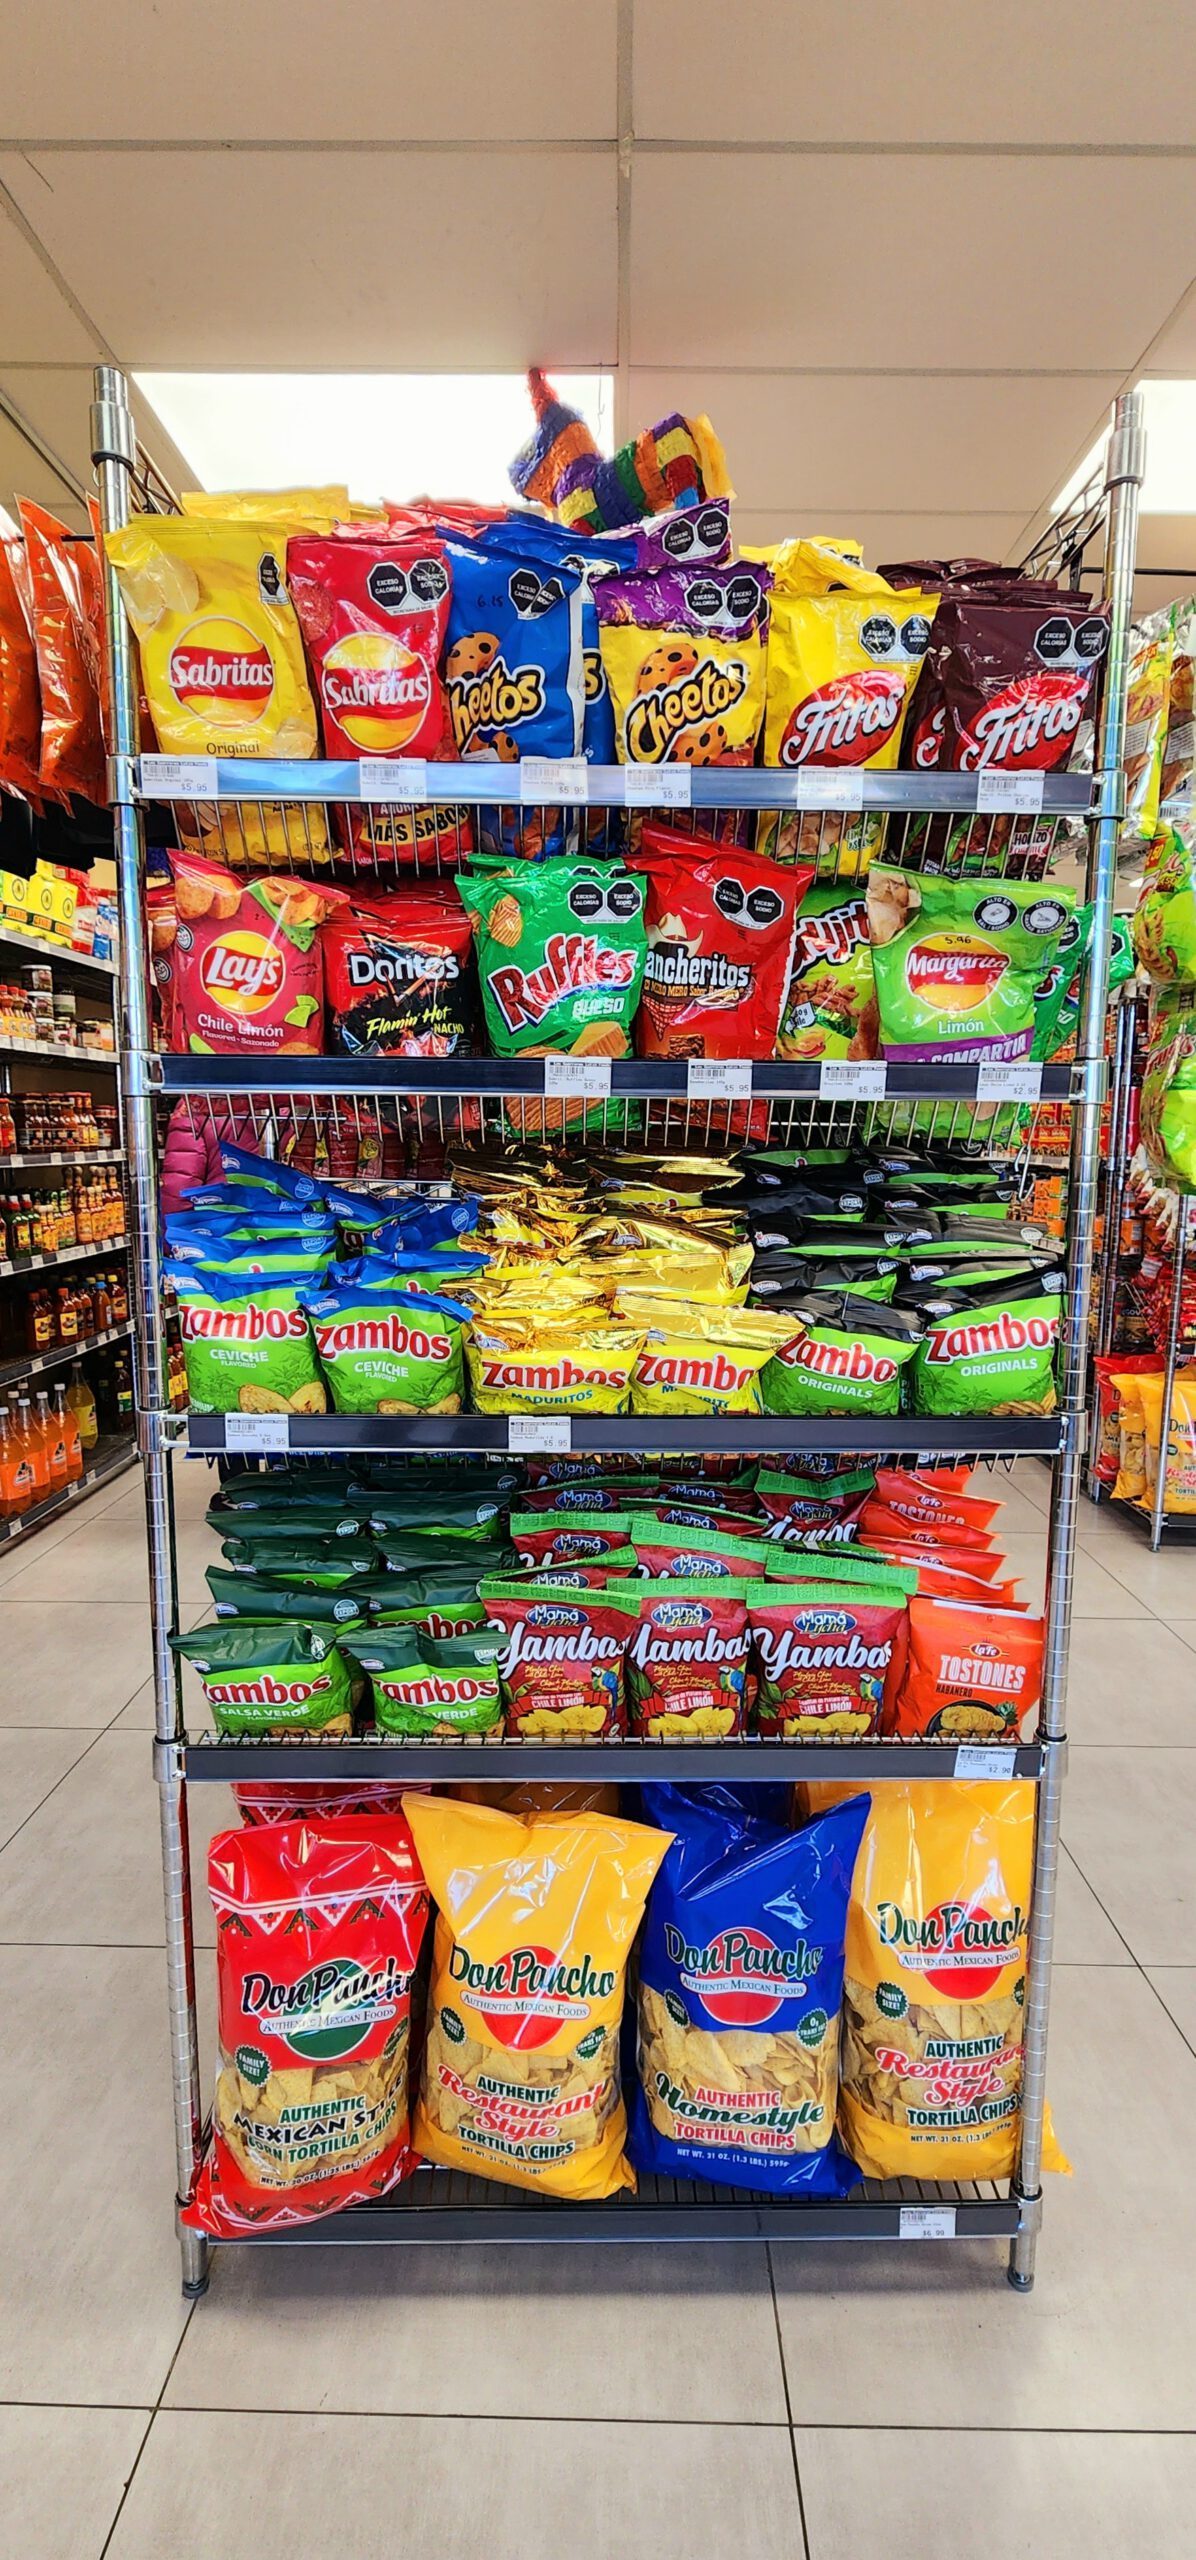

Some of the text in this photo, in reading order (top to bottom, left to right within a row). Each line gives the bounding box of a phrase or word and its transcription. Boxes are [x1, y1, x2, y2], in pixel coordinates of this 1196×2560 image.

[170, 655, 273, 687] Sabritas
[324, 674, 427, 709] Sabritas
[449, 666, 539, 752] heetos
[627, 664, 745, 760] Cheetos
[782, 688, 906, 765] Fritos
[960, 691, 1089, 770] Fritos
[206, 742, 260, 757] Original
[181, 783, 207, 791] $5.95
[399, 786, 425, 794] $5.95
[559, 786, 585, 795] $5.95
[662, 790, 689, 799] $5.95
[835, 792, 861, 801] $5.95
[1014, 797, 1040, 807] $5.95
[753, 899, 775, 907] EXCESO
[349, 954, 459, 985] Doritos
[644, 947, 750, 987] ancheritos
[907, 953, 1010, 980] Margarita
[488, 934, 637, 1036] Ruffles
[572, 996, 624, 1017] QUESO
[422, 1006, 452, 1025] Hot
[197, 1014, 284, 1037] Chile Limón
[434, 1022, 465, 1035] NACHO
[937, 1019, 985, 1034] Limón
[202, 1031, 279, 1047] Flavored Sazonado
[584, 1082, 609, 1090] $5.95
[724, 1084, 749, 1092] $5.95
[858, 1086, 883, 1094] $5.95
[1013, 1087, 1038, 1096] $2.95
[315, 1314, 452, 1361] Zambos
[209, 1349, 269, 1362] CEVICHE
[220, 1360, 257, 1369] FLAVORED
[353, 1361, 409, 1377] CEVICHE
[960, 1358, 1037, 1377] ORIGINALS
[365, 1372, 398, 1382] FLAVORED
[482, 1359, 629, 1390] Zambos
[798, 1375, 873, 1399] ORIGINALS
[261, 1437, 287, 1445] $5.95
[543, 1439, 568, 1447] $5.95
[563, 1490, 604, 1502] Mamá
[560, 1535, 601, 1549] Mamá
[679, 1556, 723, 1573] Mamá
[535, 1605, 579, 1622] Mamá
[657, 1603, 703, 1621] Mamá
[800, 1610, 847, 1627] Mamá
[939, 1655, 1026, 1690] TOSTONES
[936, 1684, 973, 1698] HABANERO
[531, 1698, 557, 1709] CHILE
[557, 1695, 585, 1707] LIMÓN
[688, 1695, 714, 1708] LIMÓN
[825, 1701, 852, 1713] LIMÓN
[219, 1704, 310, 1718] SALSA VERDE
[434, 1707, 478, 1720] VERDE
[878, 1902, 942, 1946] Don
[664, 1923, 823, 1980] Don Pancho
[954, 1956, 994, 1967] MEXICAN
[996, 1951, 1019, 1964] FOODS
[449, 1943, 617, 1998] Don Pancho
[241, 1973, 311, 2014] Don
[682, 1978, 804, 1995] AUTHENTIC MEXICAN FOODS
[879, 1988, 903, 2003] FAMILY
[881, 1997, 900, 2010] SIZE!
[463, 1994, 588, 2016] AUTHENTIC MEXICAN FOODS
[363, 2008, 395, 2021] FOODS
[925, 2035, 1004, 2059] AUTHENTIC
[238, 2053, 264, 2069] FAMILY
[242, 2065, 260, 2077] SIZE!
[438, 2065, 607, 2120] Restaurant
[476, 2076, 560, 2104] AUTHENTIC
[696, 2087, 781, 2108] AUTHENTIC
[924, 2076, 1004, 2109] Style
[279, 2097, 366, 2125] AUTHENTIC
[655, 2071, 825, 2134] Homestyle
[907, 2099, 1016, 2127] TORTILLA CHIPS
[233, 2112, 346, 2144] MEXICAN
[247, 2101, 397, 2164] CORN TORTILLA CHIPS
[476, 2109, 558, 2141] Style
[458, 2126, 574, 2160] TORTILLA CHIPS
[674, 2122, 796, 2149] TORTILLA CHIPS
[952, 2134, 964, 2142] OZ.
[677, 2148, 689, 2156] NET
[690, 2150, 705, 2158] WT.
[718, 2152, 730, 2160] OZ.
[732, 2153, 747, 2163] (1.3
[260, 2176, 274, 2184] NET
